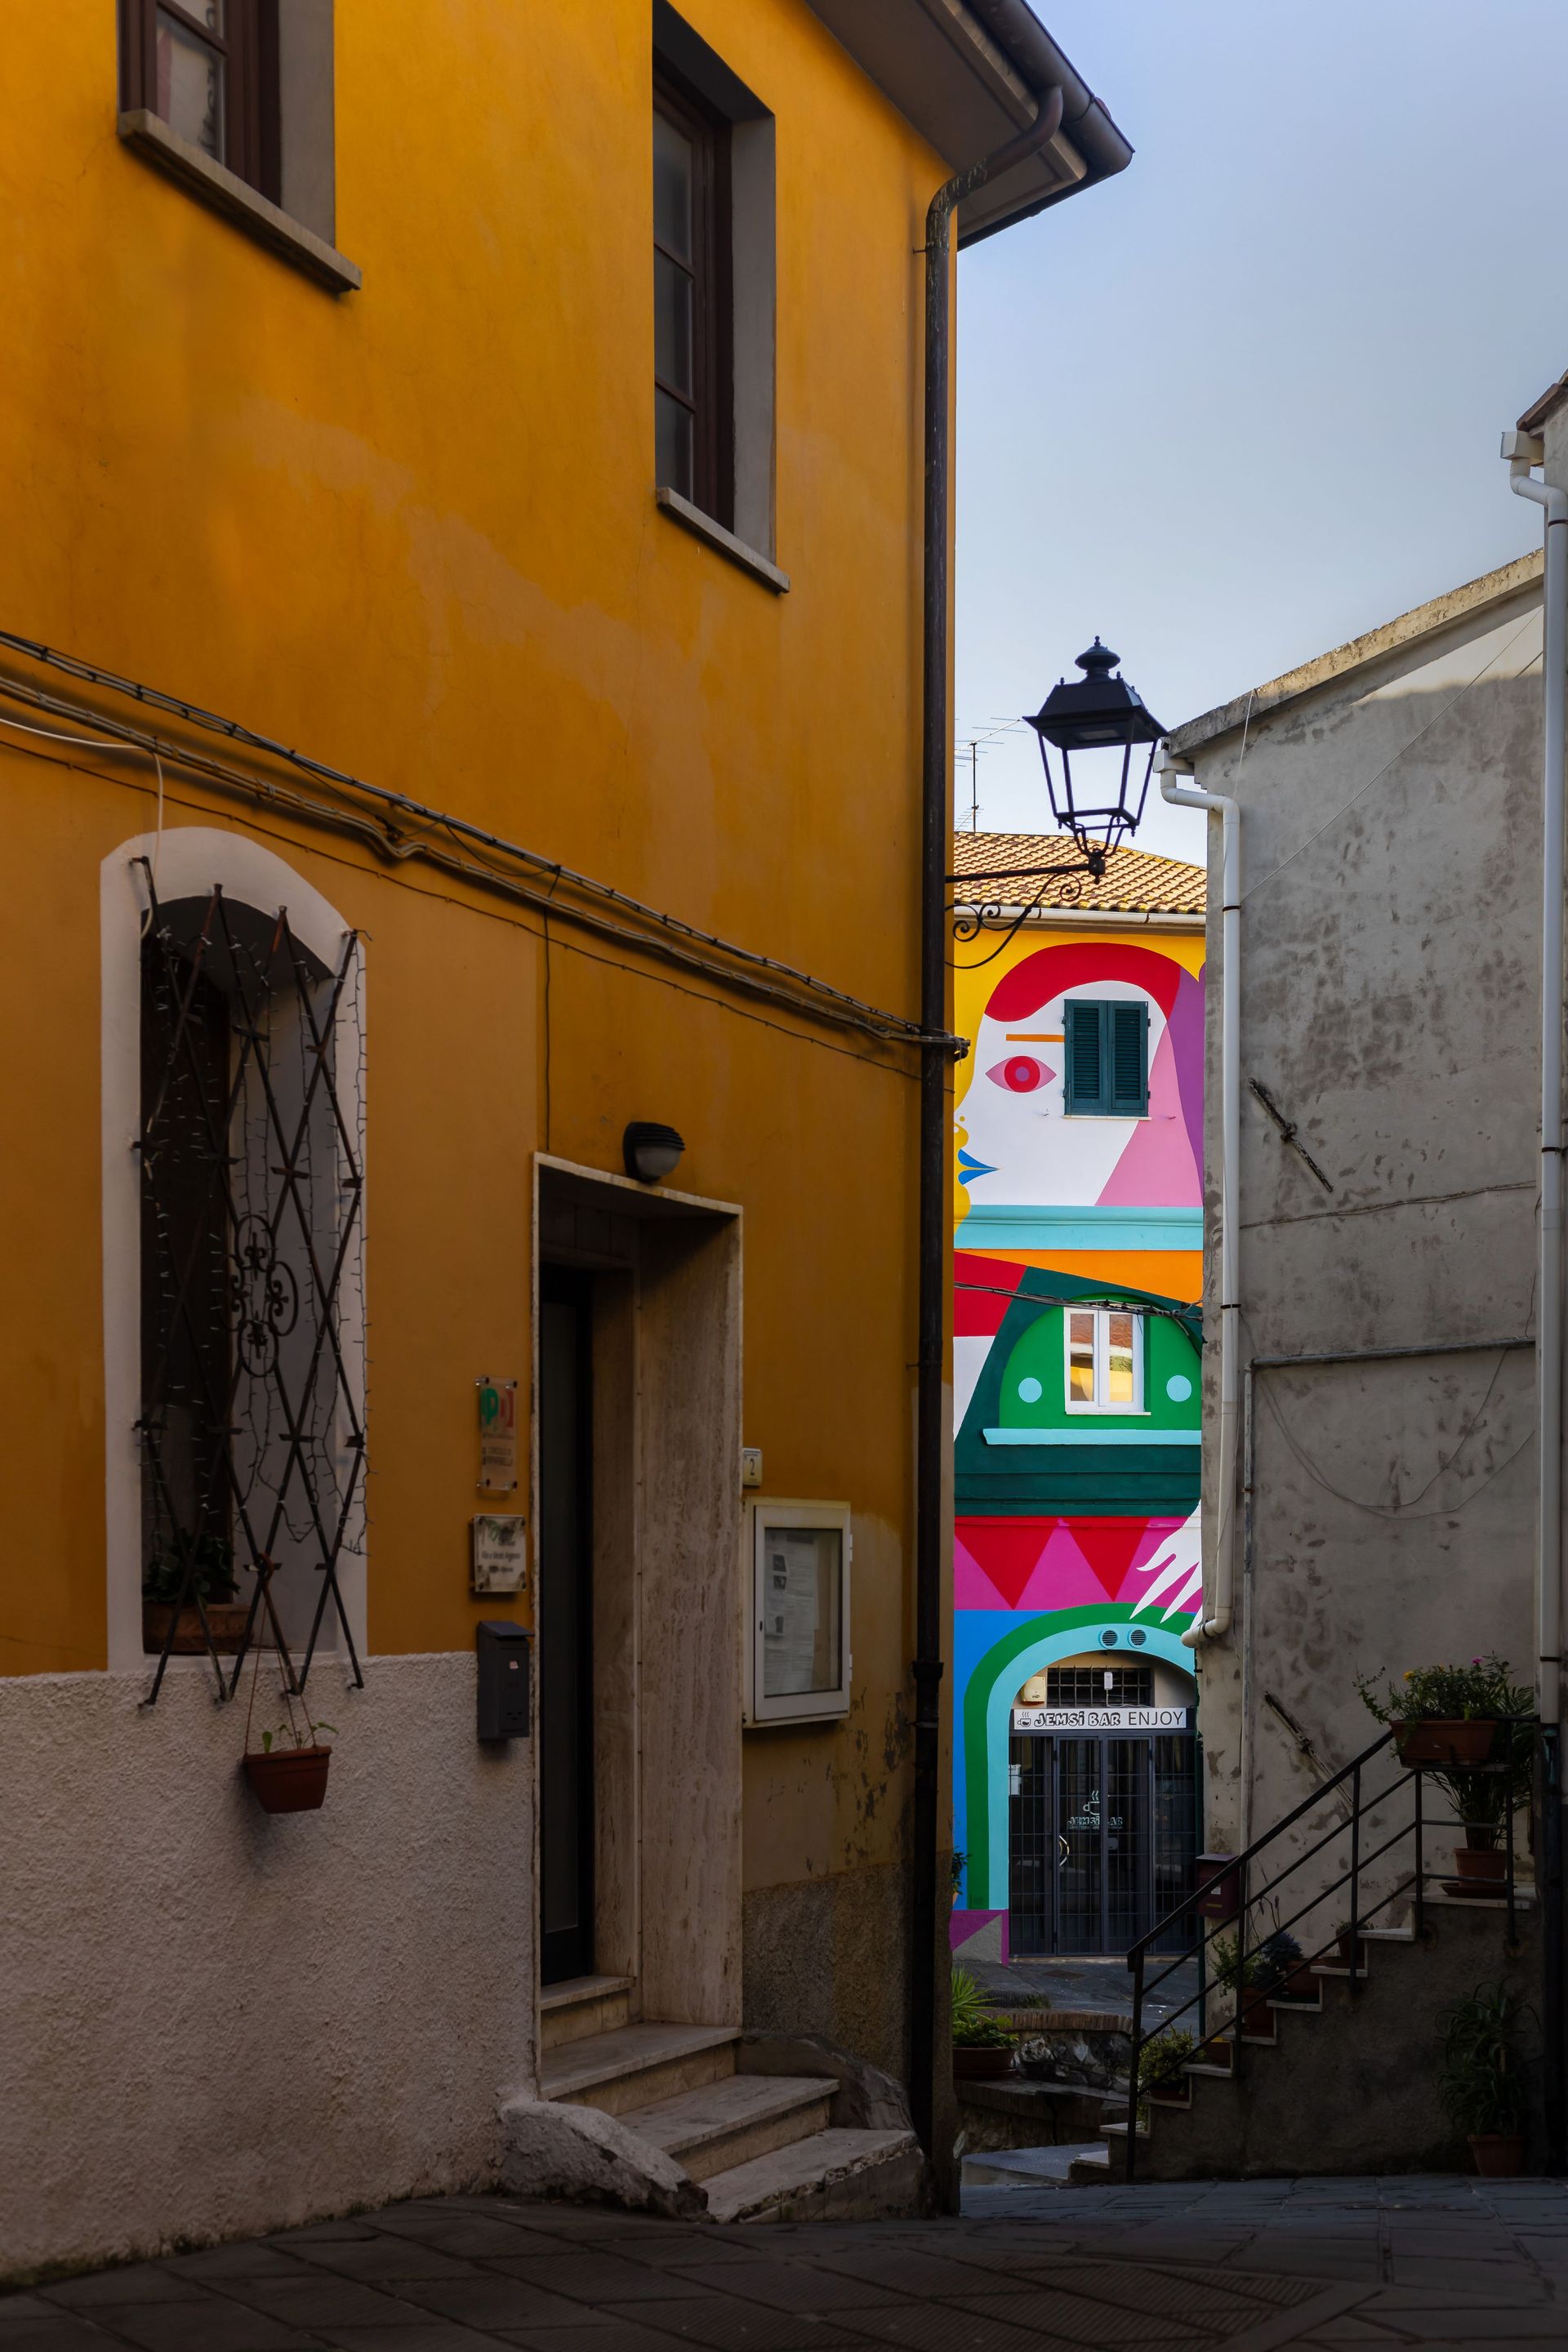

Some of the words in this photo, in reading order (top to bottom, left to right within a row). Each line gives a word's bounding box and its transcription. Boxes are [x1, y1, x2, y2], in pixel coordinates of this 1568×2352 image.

[750, 1458, 755, 1476] 2
[1088, 1712, 1121, 1726] BAR
[1129, 1711, 1183, 1726] ENJOY
